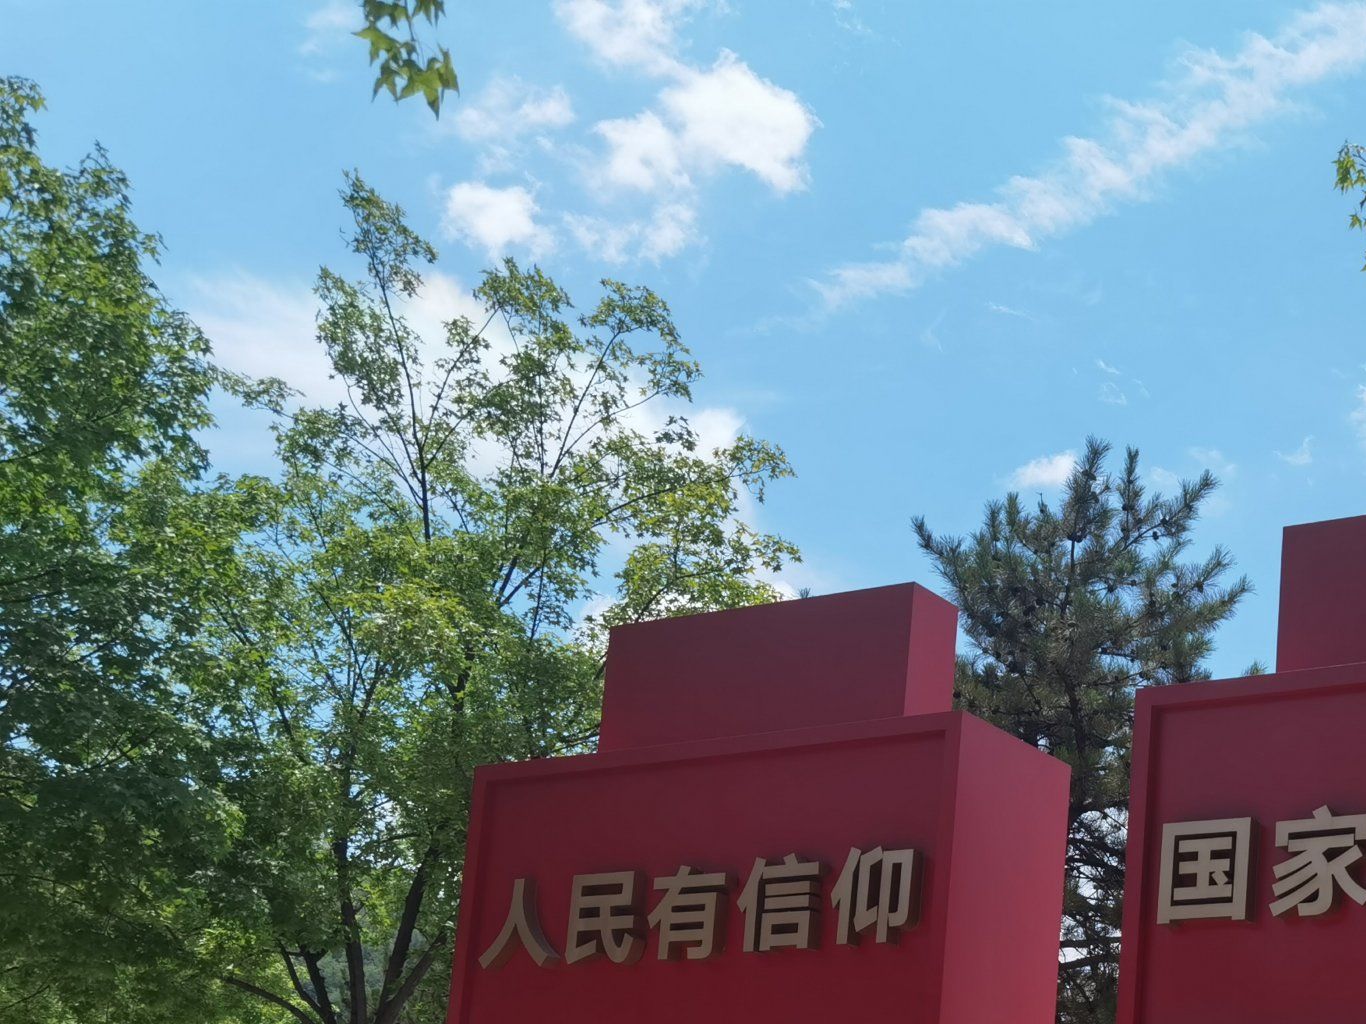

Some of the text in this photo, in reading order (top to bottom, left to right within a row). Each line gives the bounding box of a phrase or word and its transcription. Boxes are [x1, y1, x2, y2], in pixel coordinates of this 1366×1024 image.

[478, 845, 924, 970] 人民有信仰
